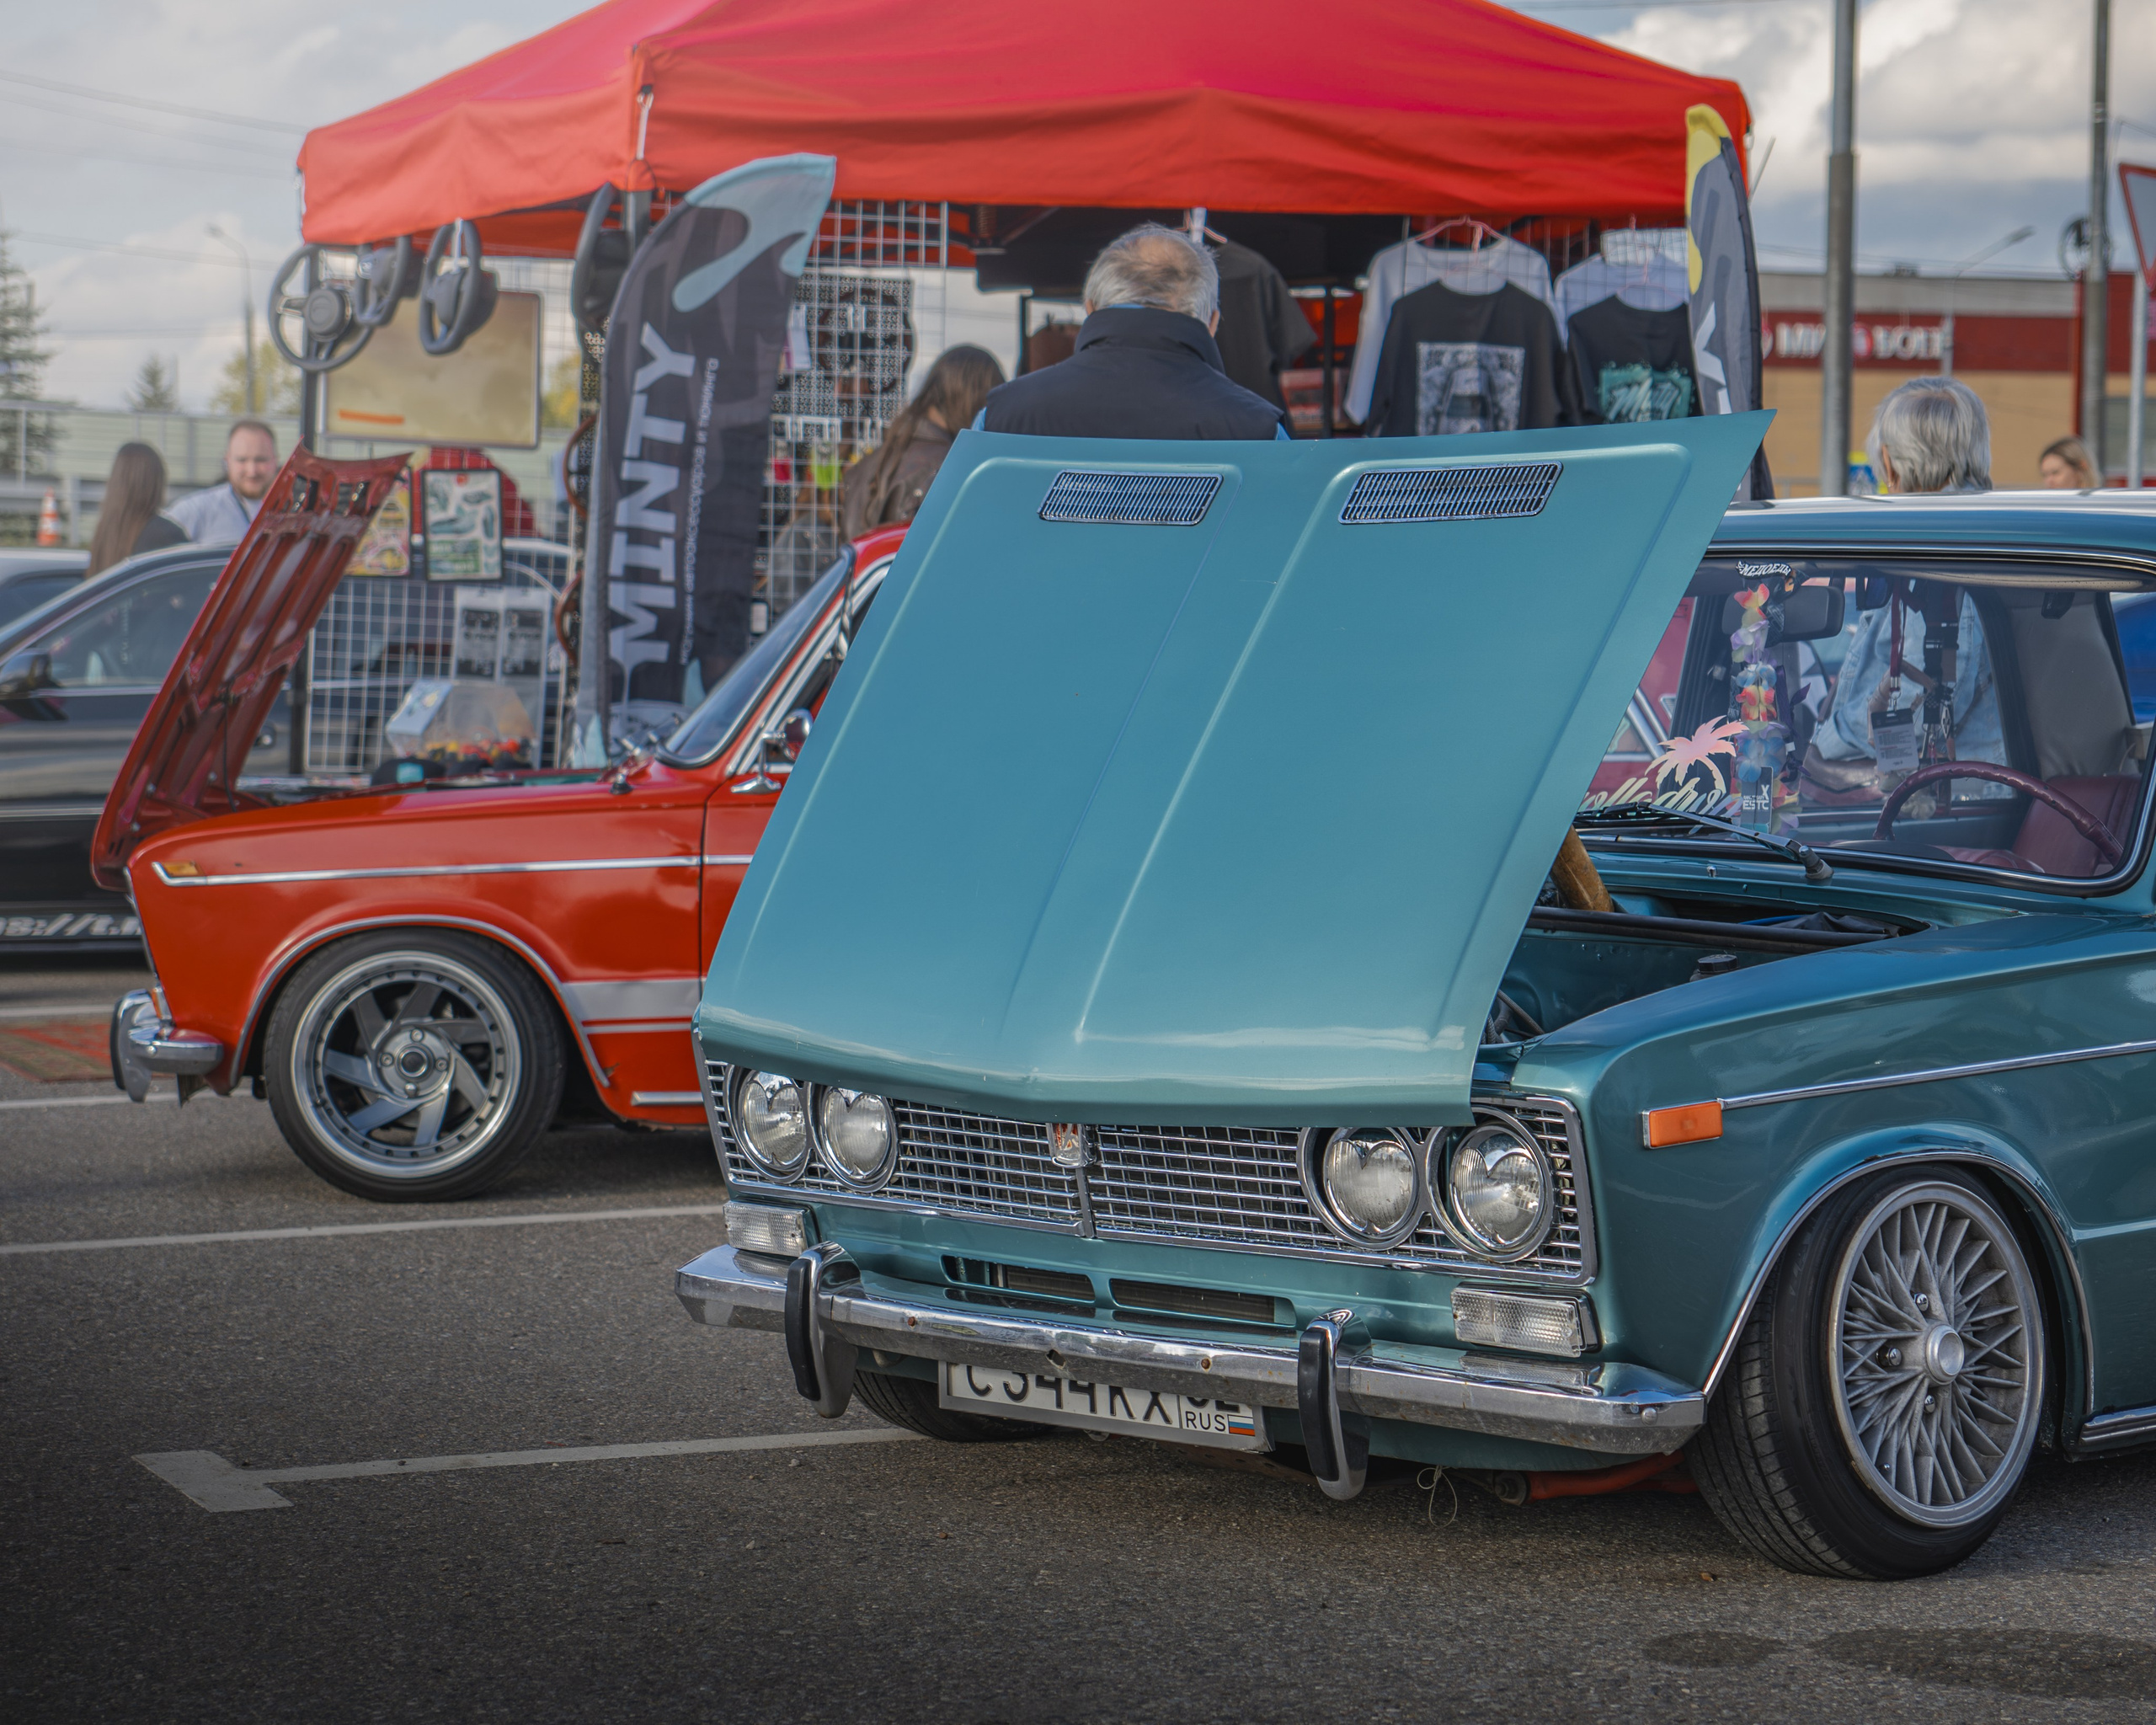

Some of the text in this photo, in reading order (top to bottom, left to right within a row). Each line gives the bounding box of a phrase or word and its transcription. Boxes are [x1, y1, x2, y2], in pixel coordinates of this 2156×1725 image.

[606, 321, 696, 663] MINTY
[684, 445, 706, 593] автоаксессуаров
[697, 357, 720, 428] тюнинга
[1740, 563, 1791, 577] МЕДОЕДЫ
[1186, 1410, 1226, 1433] RUS
